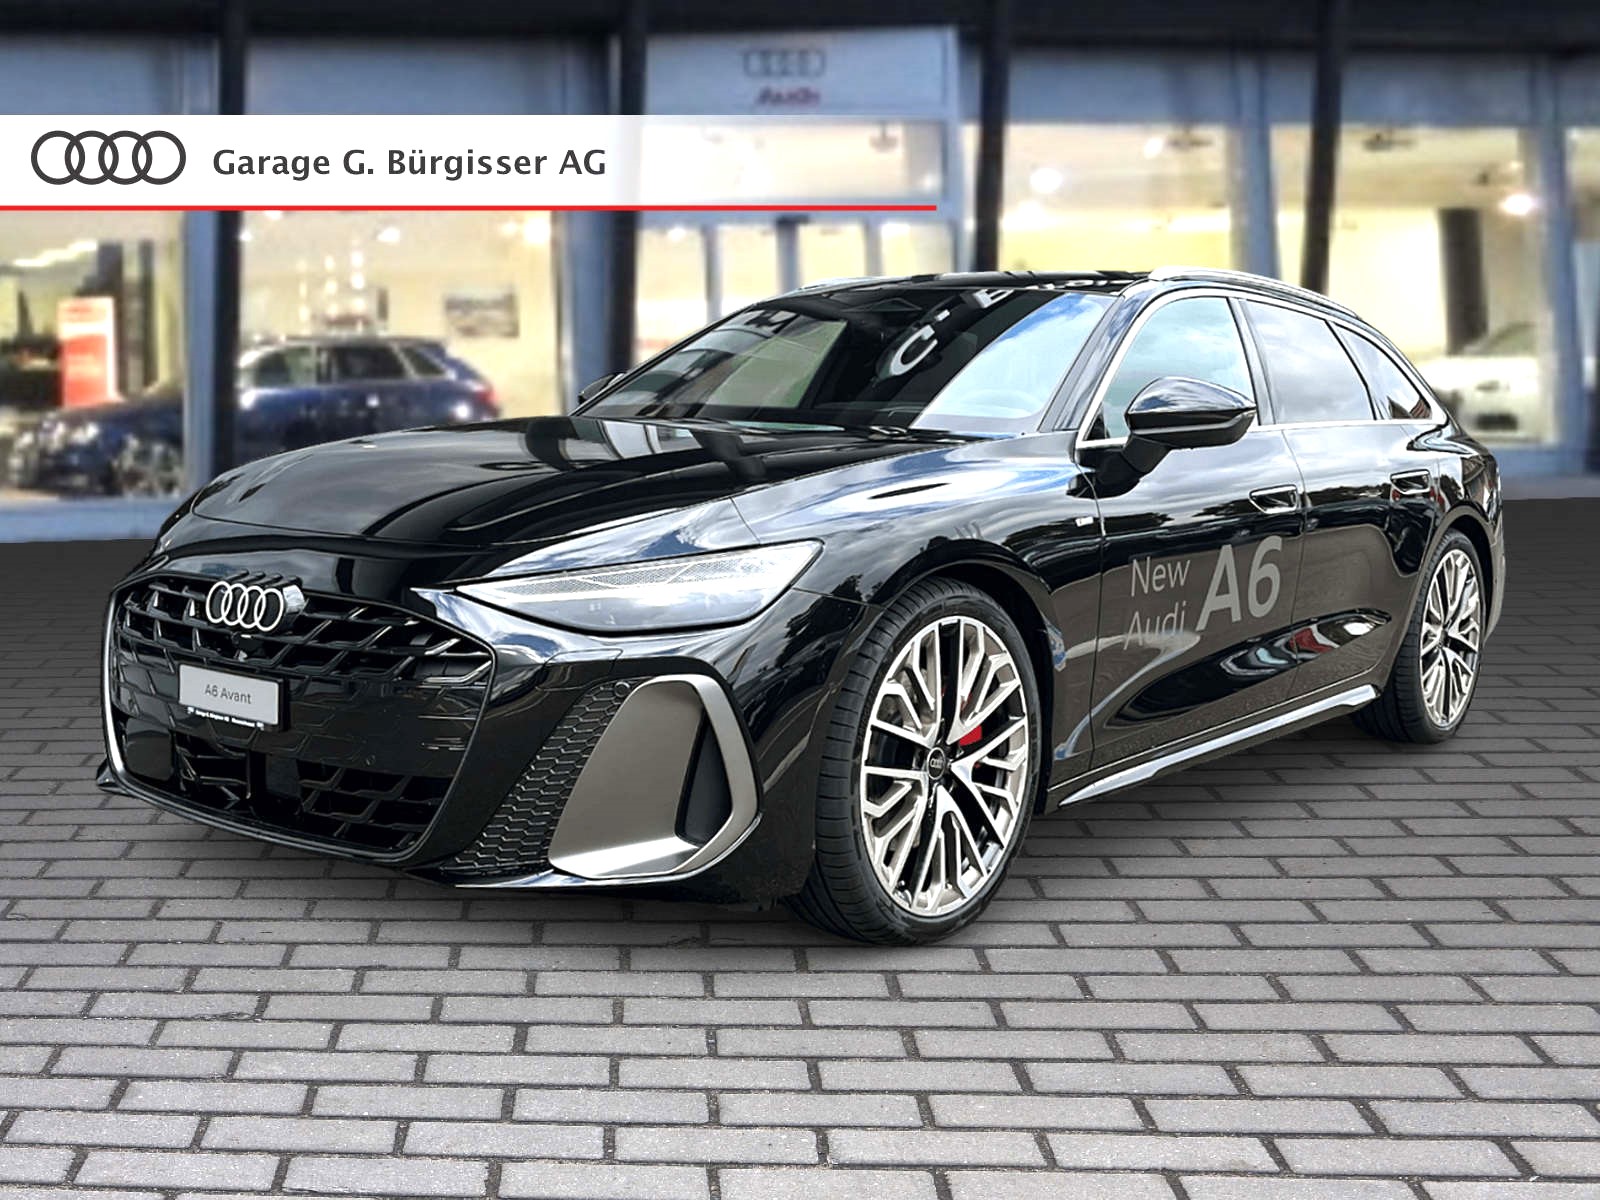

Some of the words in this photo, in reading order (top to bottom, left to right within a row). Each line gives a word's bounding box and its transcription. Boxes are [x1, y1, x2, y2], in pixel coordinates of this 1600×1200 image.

[1131, 556, 1191, 597] New
[1195, 535, 1283, 632] A6
[1124, 600, 1187, 651] Audi
[205, 684, 218, 697] A6
[220, 687, 252, 704] Avant
